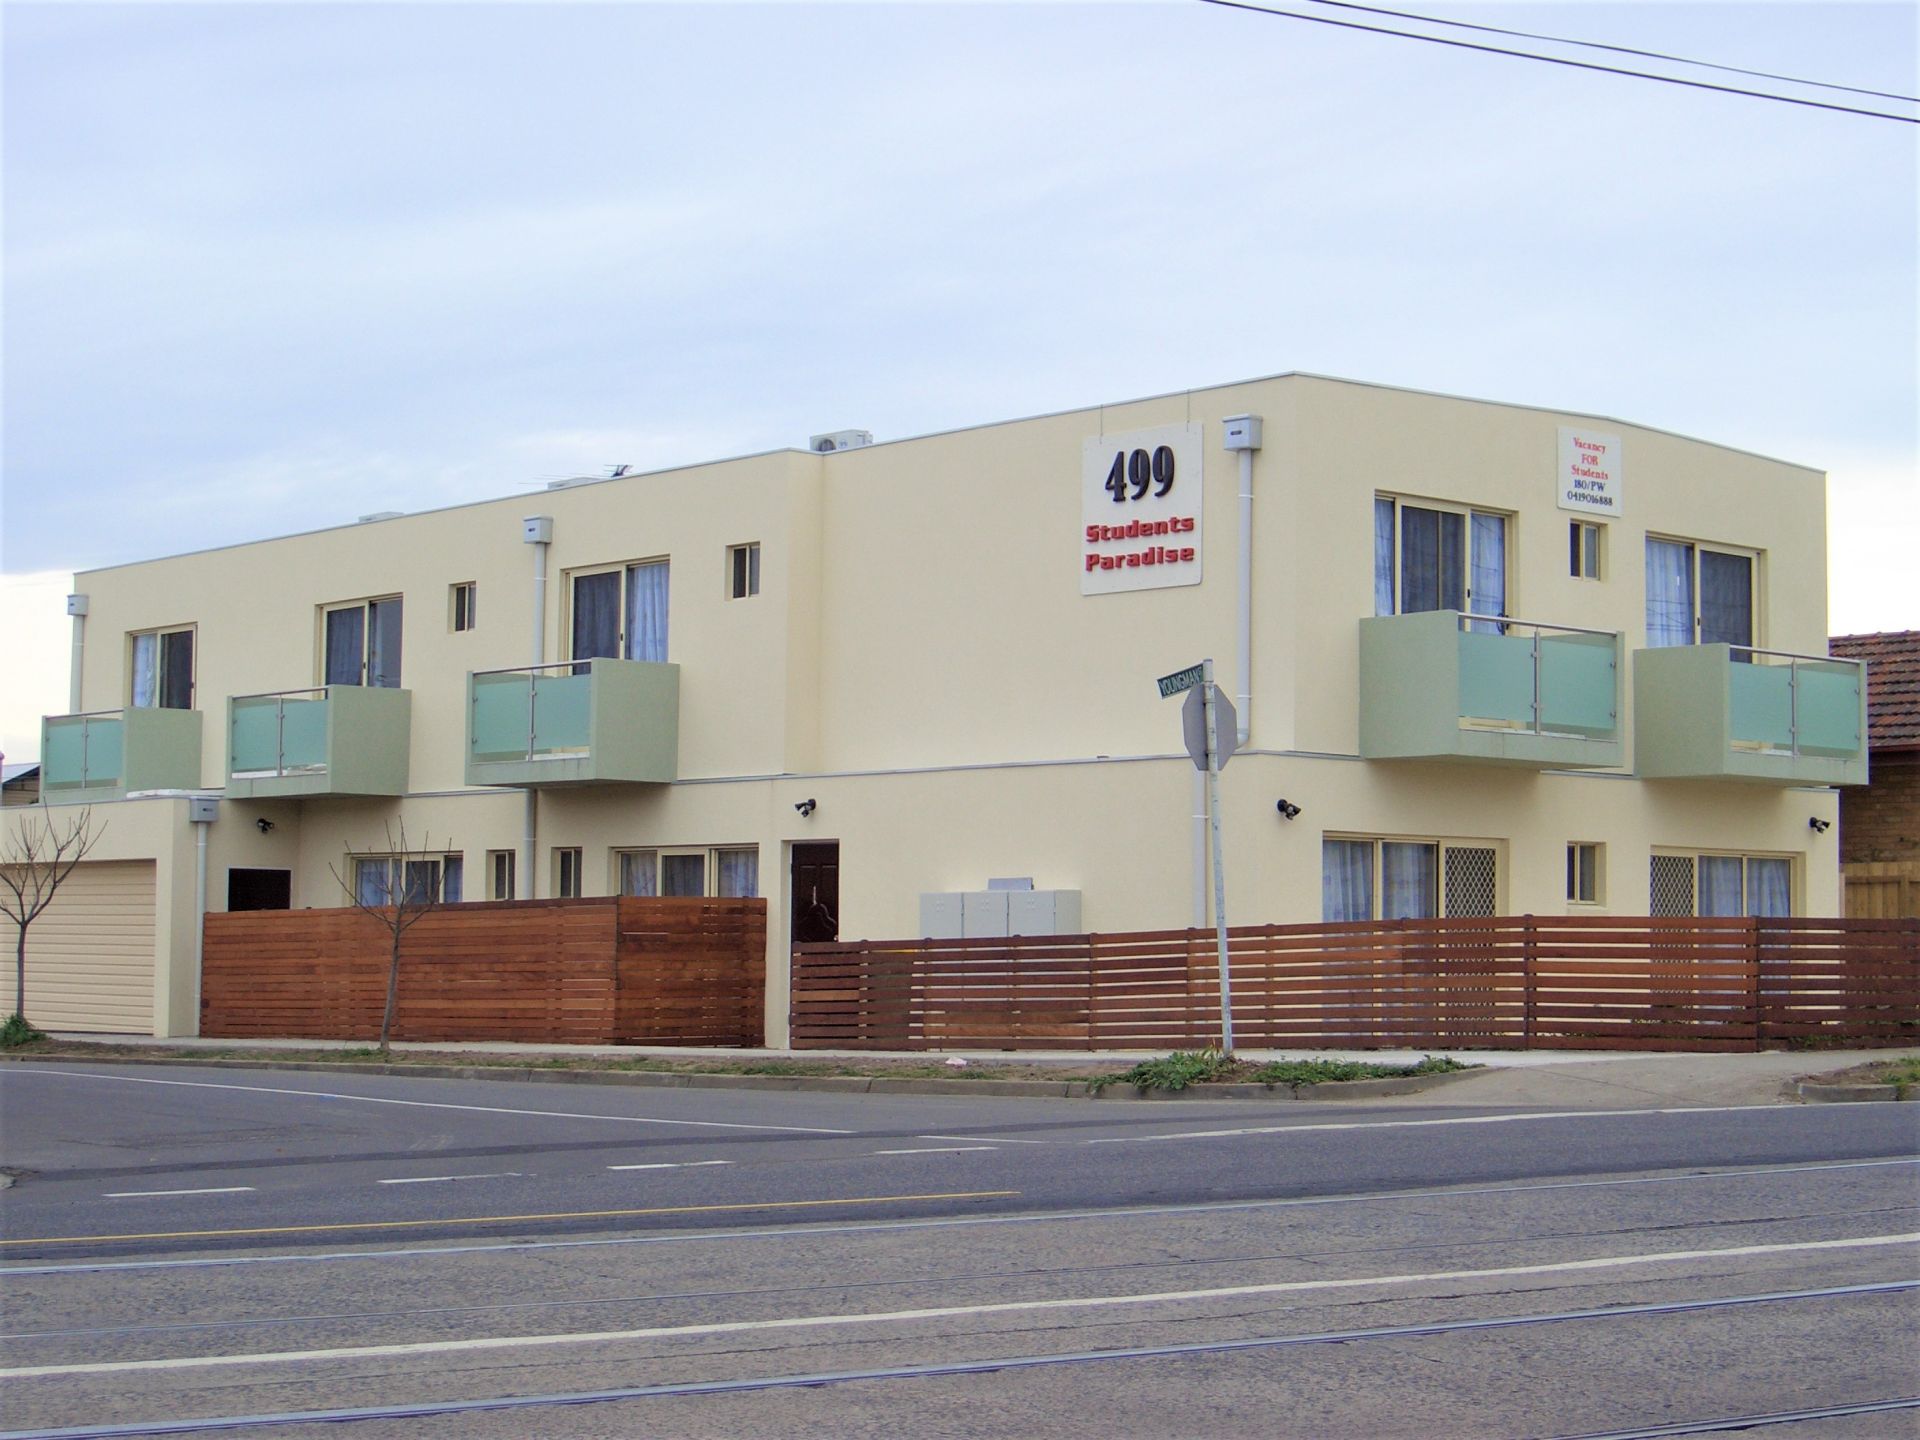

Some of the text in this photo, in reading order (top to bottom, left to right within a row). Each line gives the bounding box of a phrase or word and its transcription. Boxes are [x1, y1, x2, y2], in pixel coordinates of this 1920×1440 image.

[1573, 437, 1606, 454] Vacancy
[1581, 453, 1598, 466] FOR
[1105, 445, 1175, 502] 499
[1571, 464, 1608, 480] Students
[1086, 517, 1194, 542] Students
[1086, 547, 1194, 572] Paradise
